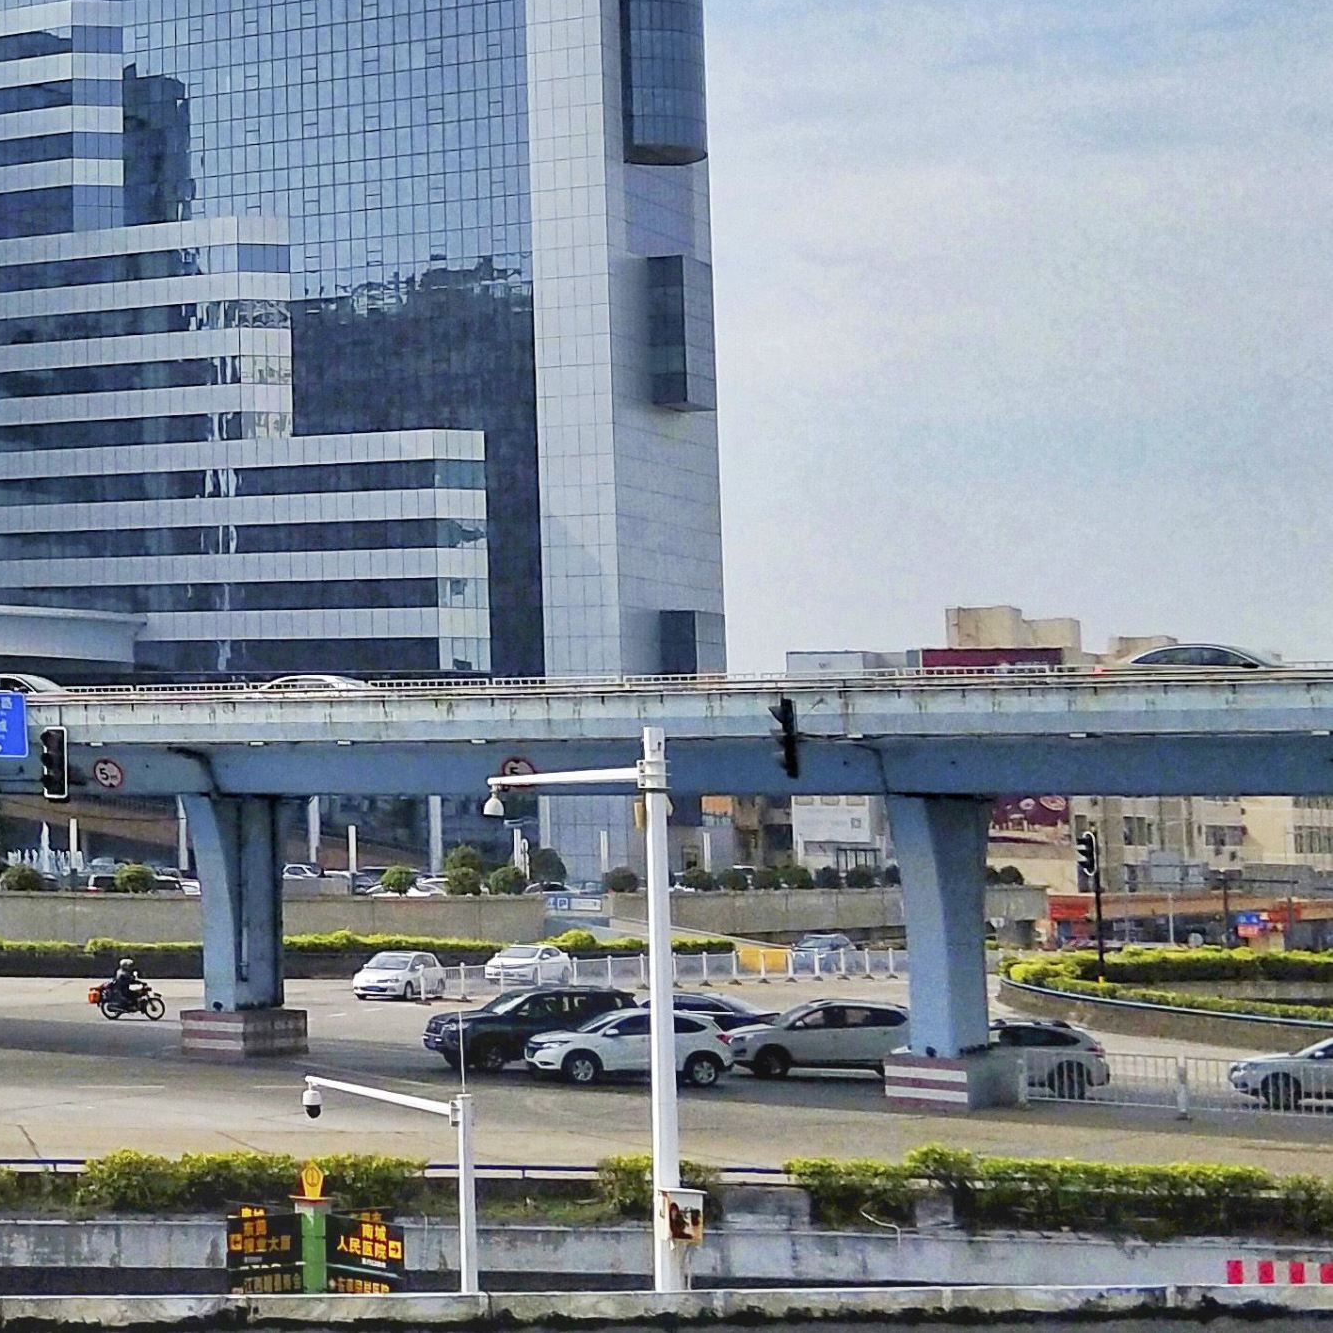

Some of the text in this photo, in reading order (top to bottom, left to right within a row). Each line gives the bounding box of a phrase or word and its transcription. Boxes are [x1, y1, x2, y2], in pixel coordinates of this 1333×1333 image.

[361, 1223, 387, 1243] 南城
[336, 1234, 387, 1260] 人民医院
